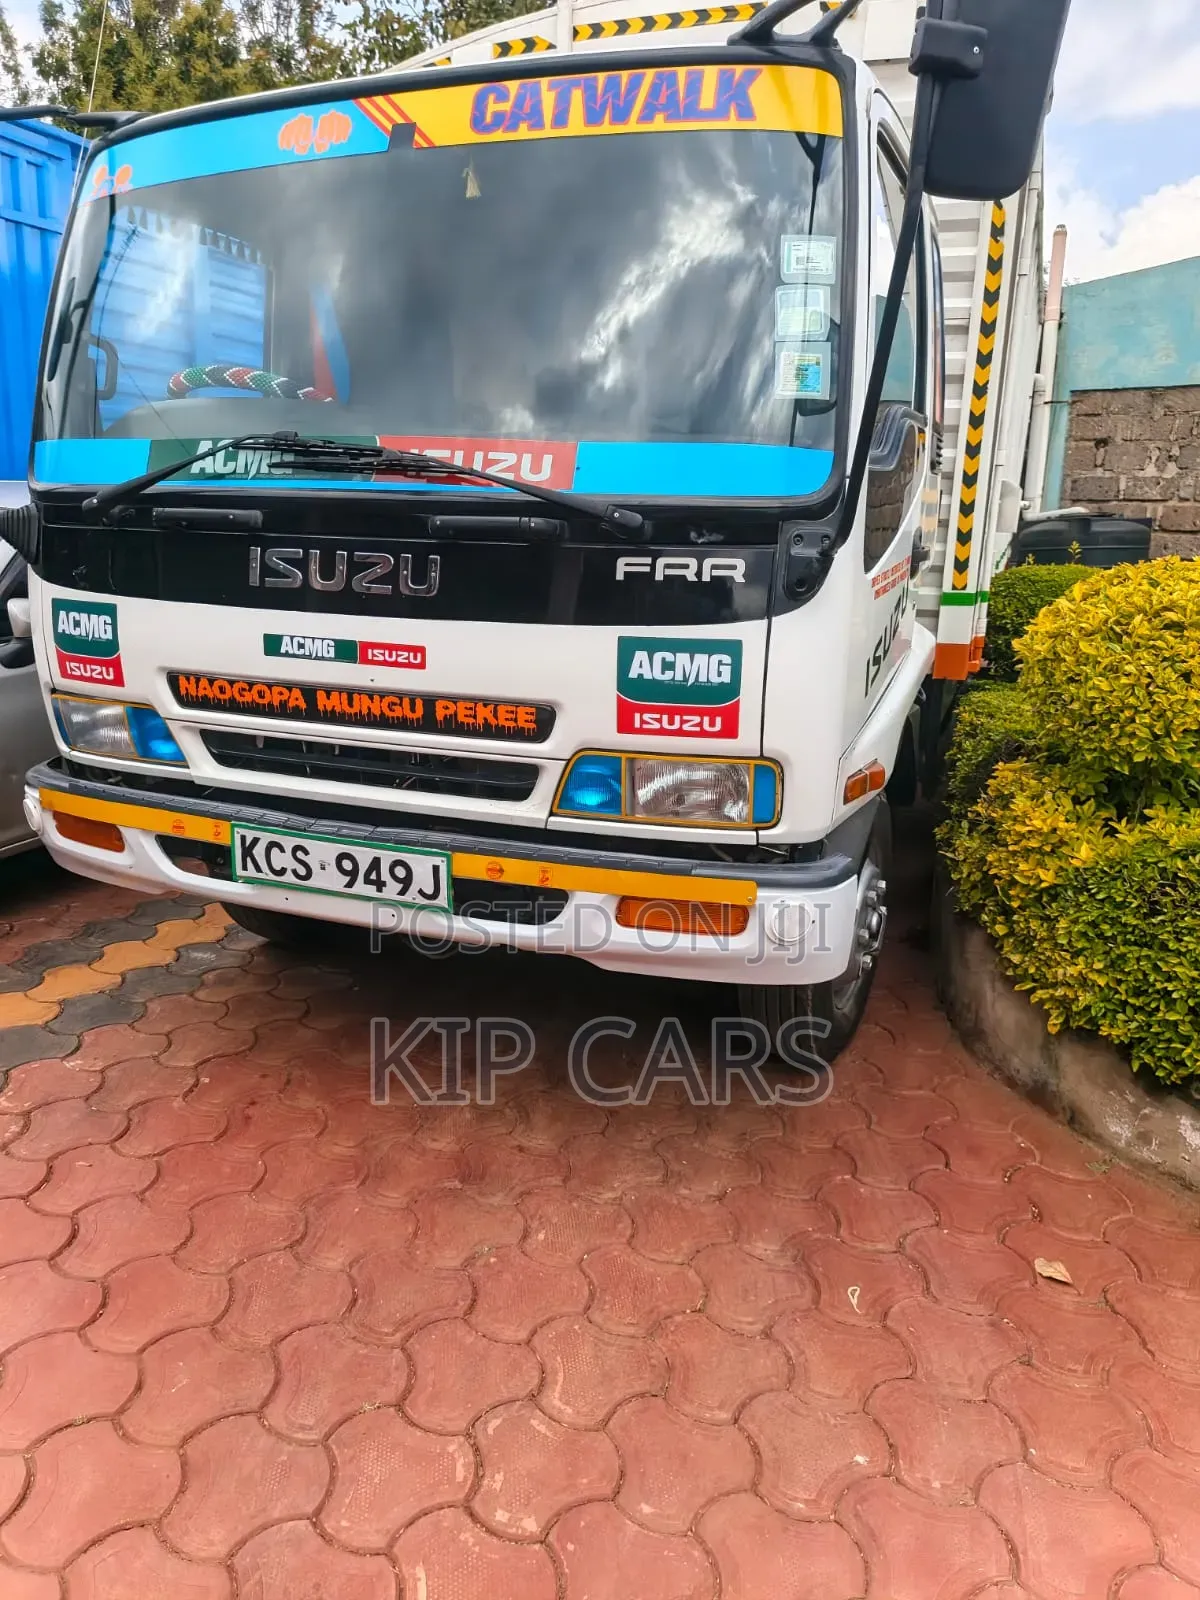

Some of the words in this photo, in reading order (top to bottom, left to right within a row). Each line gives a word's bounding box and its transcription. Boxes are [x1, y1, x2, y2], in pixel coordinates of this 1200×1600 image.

[470, 68, 763, 135] CATWALK
[405, 448, 553, 482] UZU
[249, 546, 441, 597] ISUZU
[615, 556, 746, 583] FRR
[57, 610, 113, 642] ACMG
[280, 635, 336, 660] ACMG
[367, 648, 422, 664] ISUZU
[66, 661, 115, 680] ISUZU
[628, 650, 732, 687] ACMG
[178, 674, 307, 718] NAOGOPA
[316, 689, 424, 727] MUNGU
[434, 699, 538, 737] PEKEE
[634, 712, 722, 732] ISUZU
[240, 834, 313, 882] KCS
[335, 851, 441, 901] 949J
